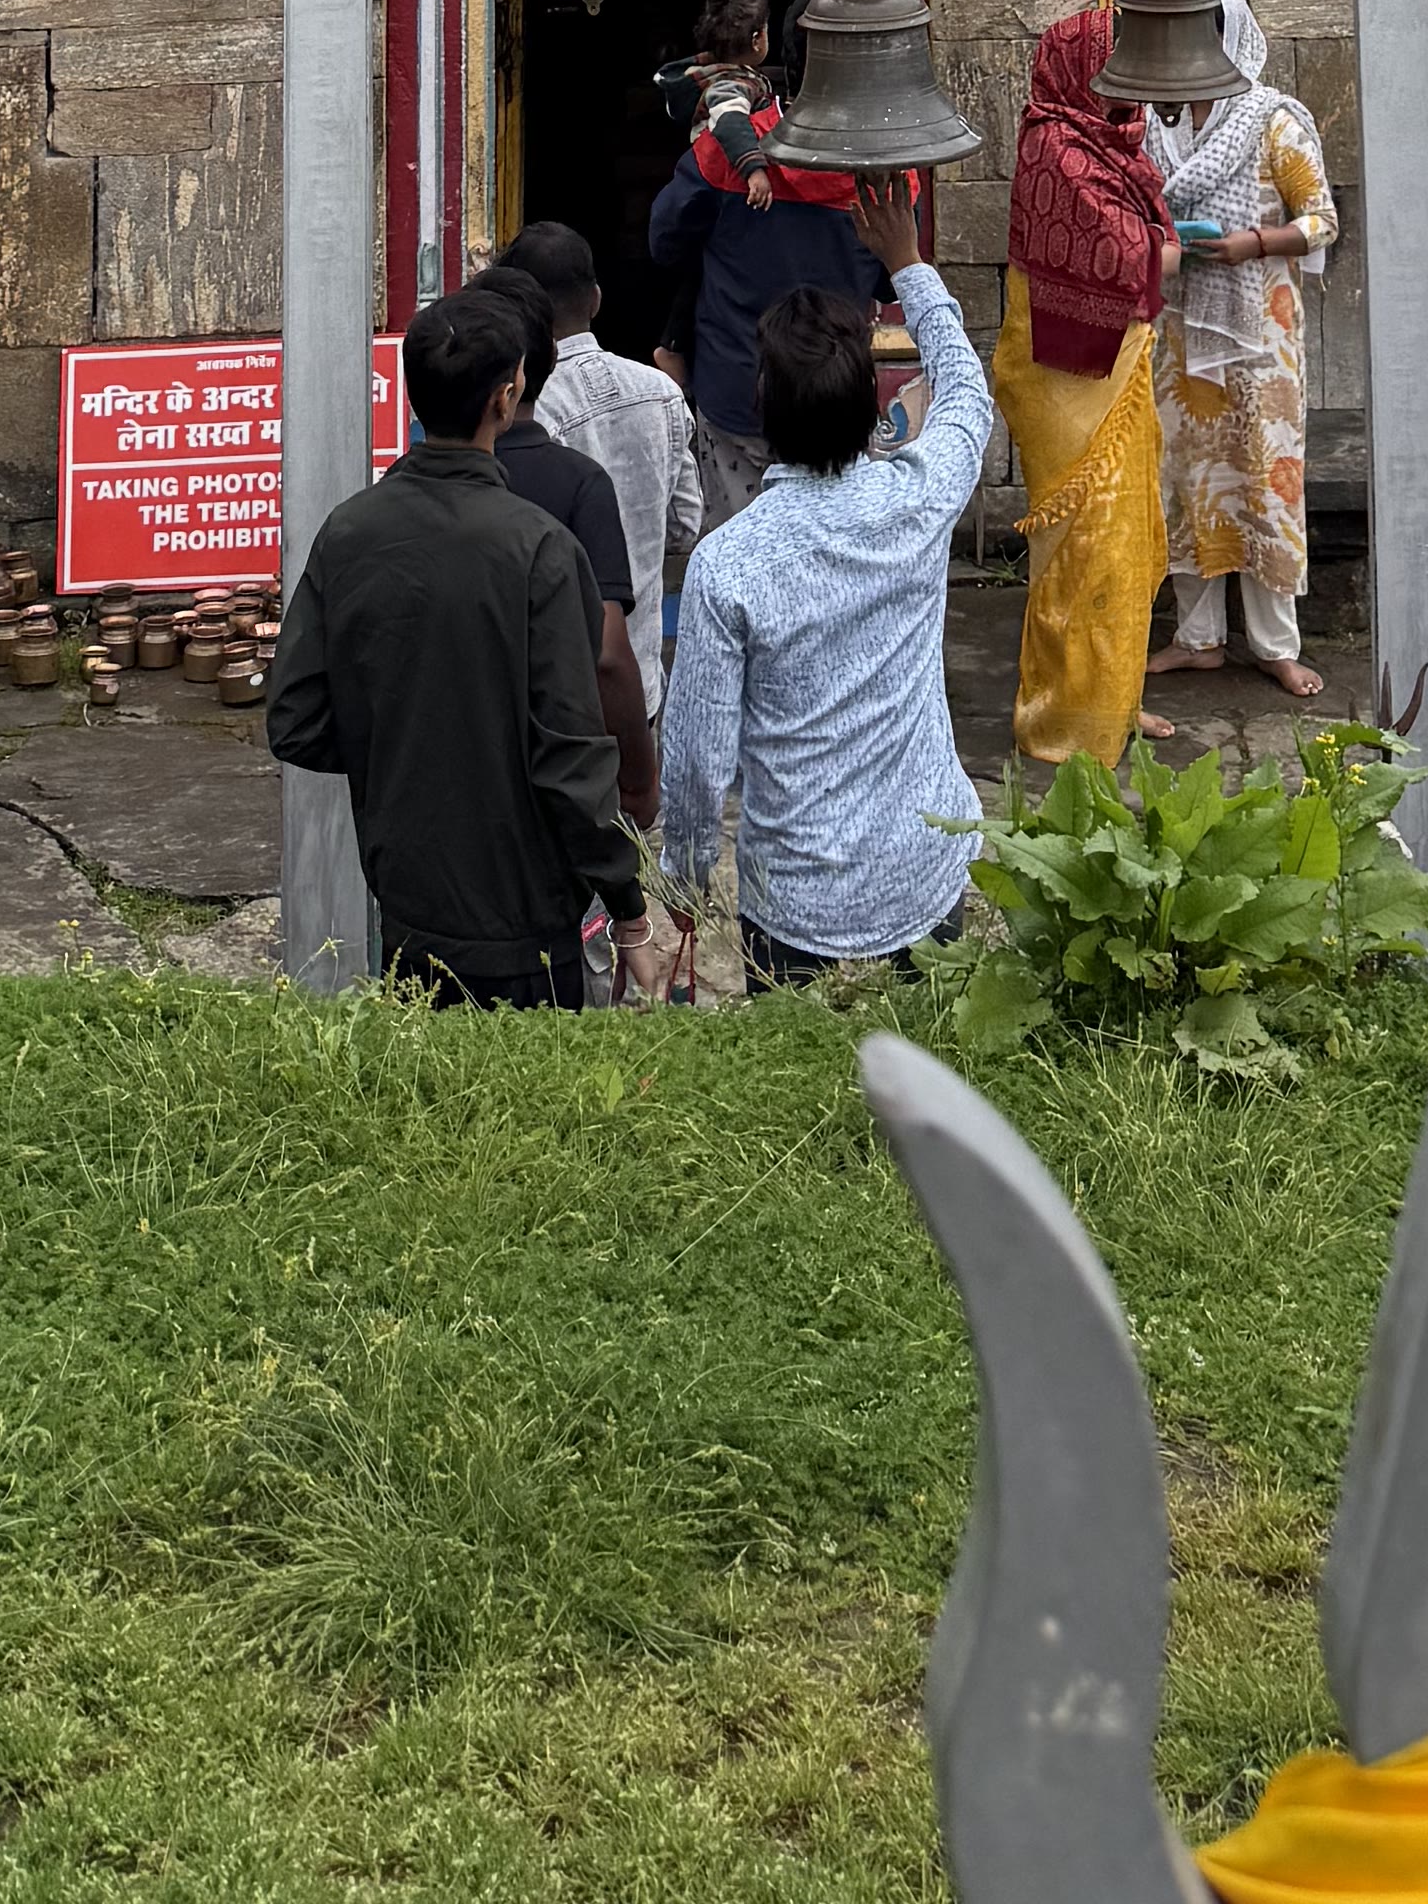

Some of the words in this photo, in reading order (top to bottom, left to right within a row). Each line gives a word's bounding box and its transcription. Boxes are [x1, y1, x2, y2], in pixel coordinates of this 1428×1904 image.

[81, 384, 162, 417] मन्दिर
[165, 380, 195, 413] के
[202, 383, 278, 412] अन्दर
[116, 418, 179, 451] लेना
[185, 420, 254, 448] सख्त
[82, 476, 179, 501] TAKING
[188, 471, 282, 496] PHOTO
[138, 503, 190, 526] THE
[197, 498, 282, 523] TEMPL
[153, 526, 282, 553] PROHIBIT
